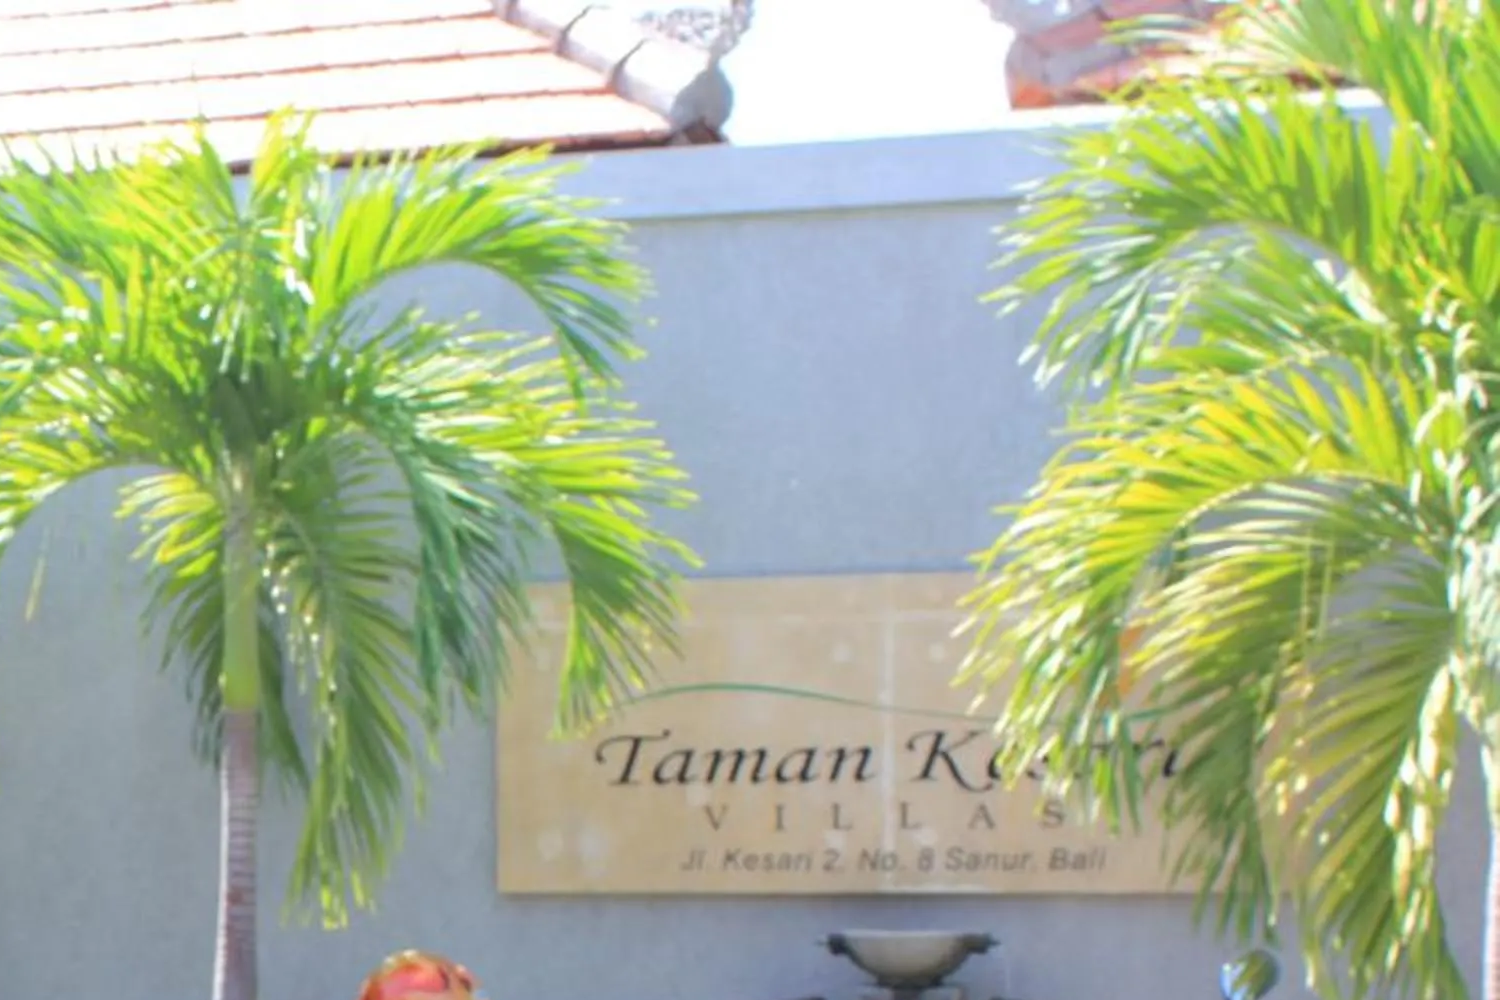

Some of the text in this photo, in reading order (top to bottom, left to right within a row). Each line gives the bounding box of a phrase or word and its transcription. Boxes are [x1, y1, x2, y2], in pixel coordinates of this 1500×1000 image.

[594, 728, 1179, 794] Taman Keri
[704, 800, 1066, 832] VILLAS
[723, 847, 815, 872] Kesari
[916, 846, 936, 872] 8
[1048, 846, 1108, 873] Bali
